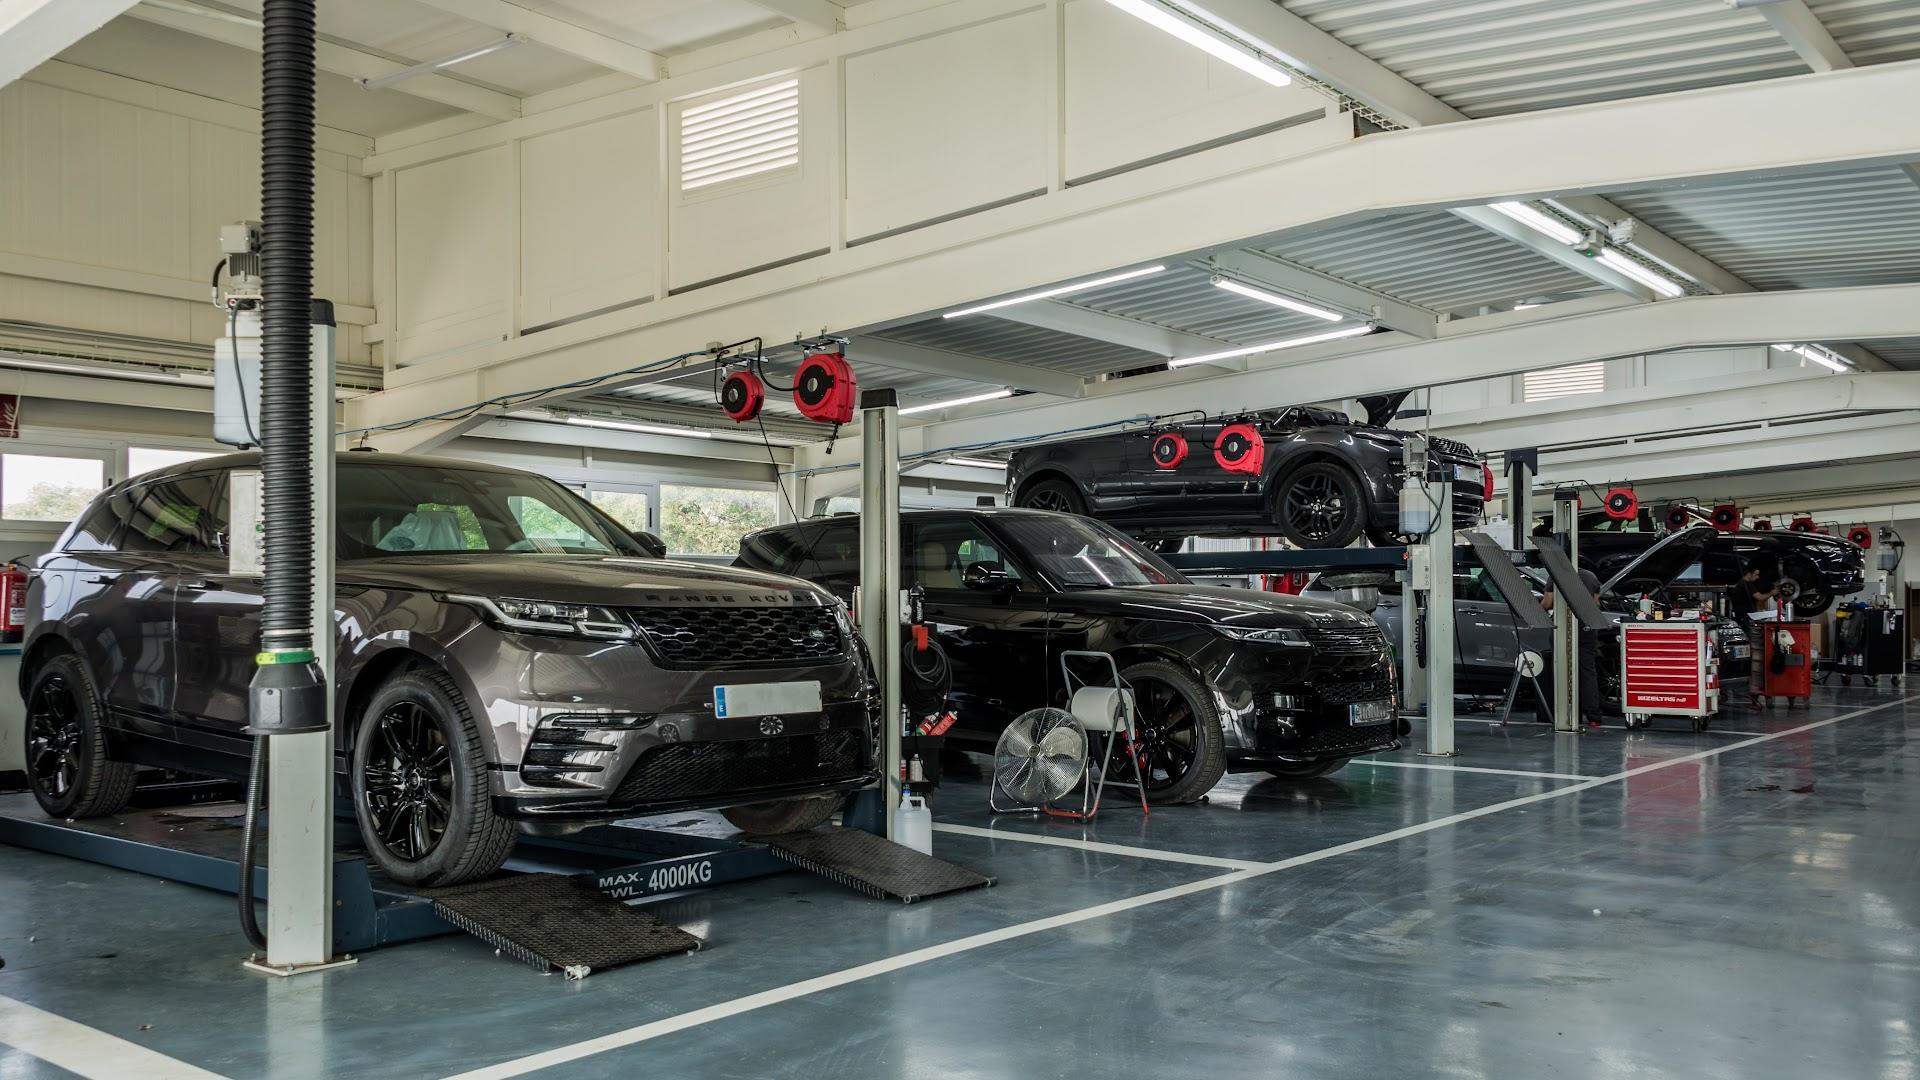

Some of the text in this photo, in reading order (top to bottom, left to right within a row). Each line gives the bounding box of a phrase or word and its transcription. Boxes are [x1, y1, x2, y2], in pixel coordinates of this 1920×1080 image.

[644, 593, 736, 603] RANGE
[719, 704, 724, 713] E
[599, 872, 644, 888] MAX.
[648, 860, 712, 892] 4000KG
[602, 886, 644, 898] WL.
